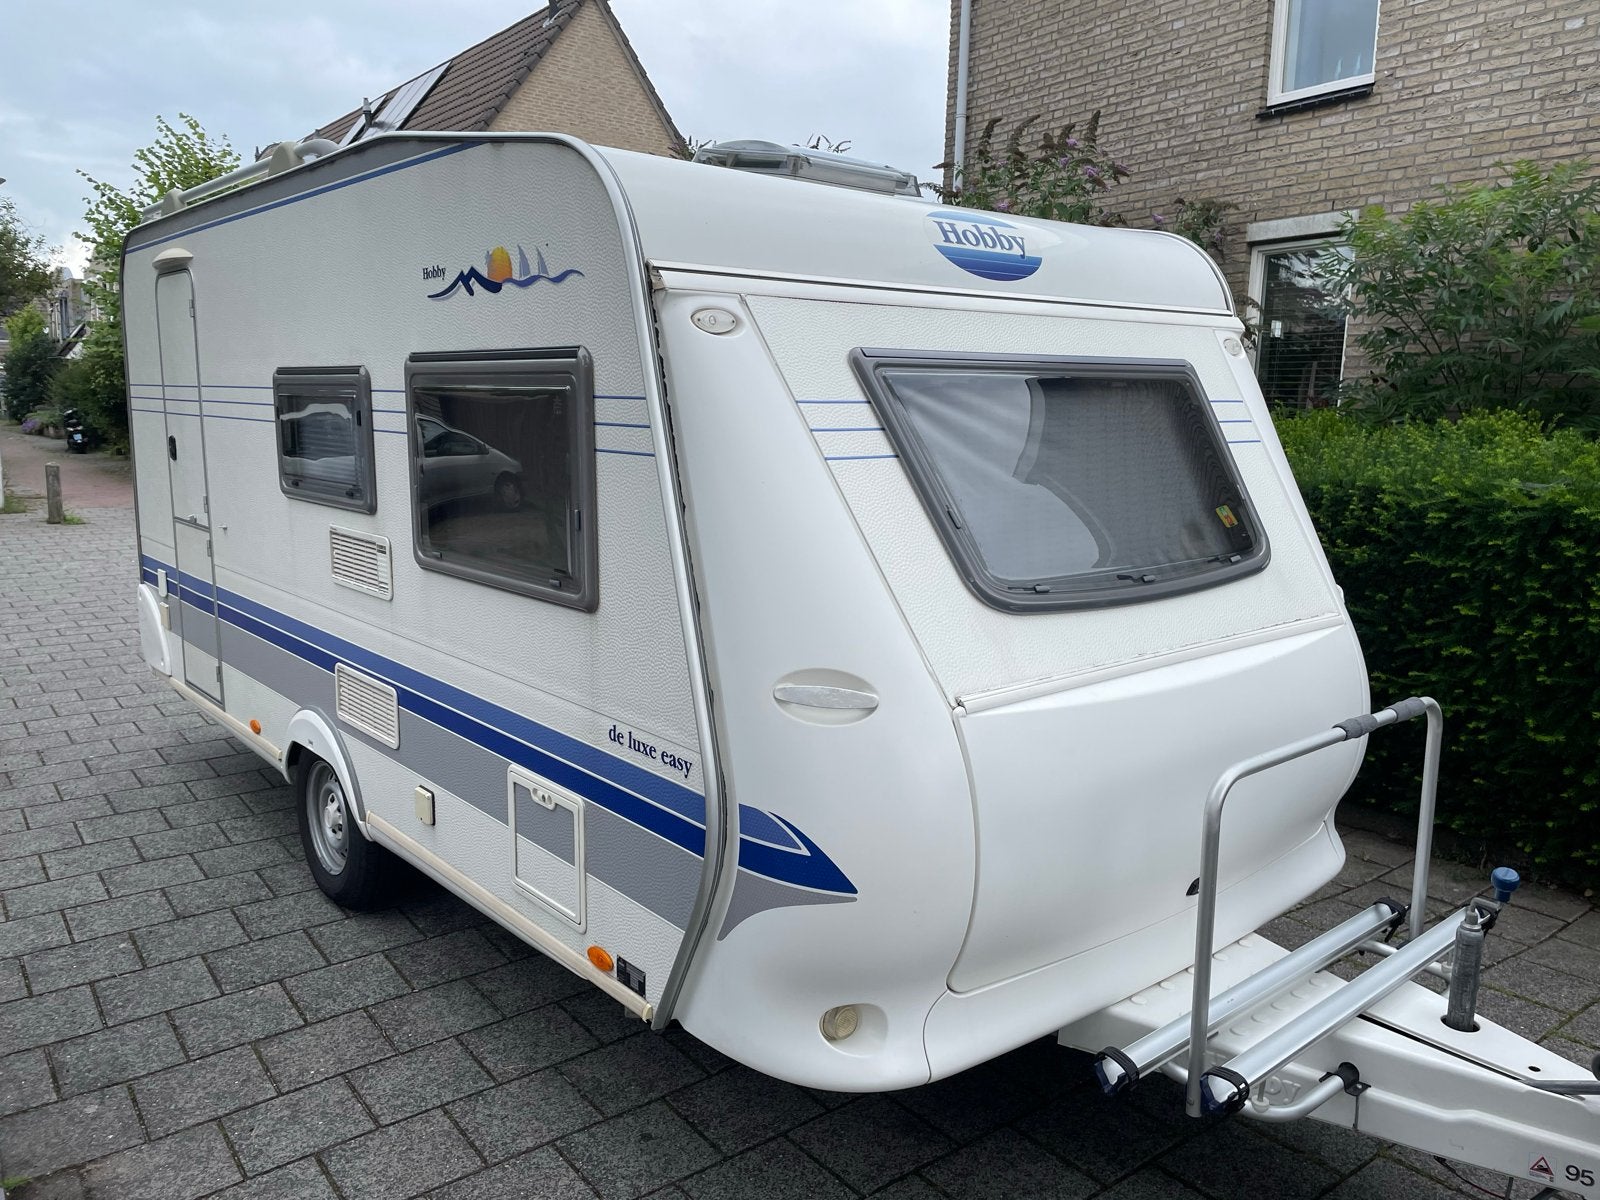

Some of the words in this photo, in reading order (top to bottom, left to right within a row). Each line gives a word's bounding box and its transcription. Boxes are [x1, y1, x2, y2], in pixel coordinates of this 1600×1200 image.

[932, 220, 1026, 260] Hobby
[422, 265, 447, 281] Hobby
[608, 724, 625, 746] de
[628, 731, 657, 760] luxe
[660, 750, 693, 779] easy
[1565, 1164, 1596, 1187] 95
